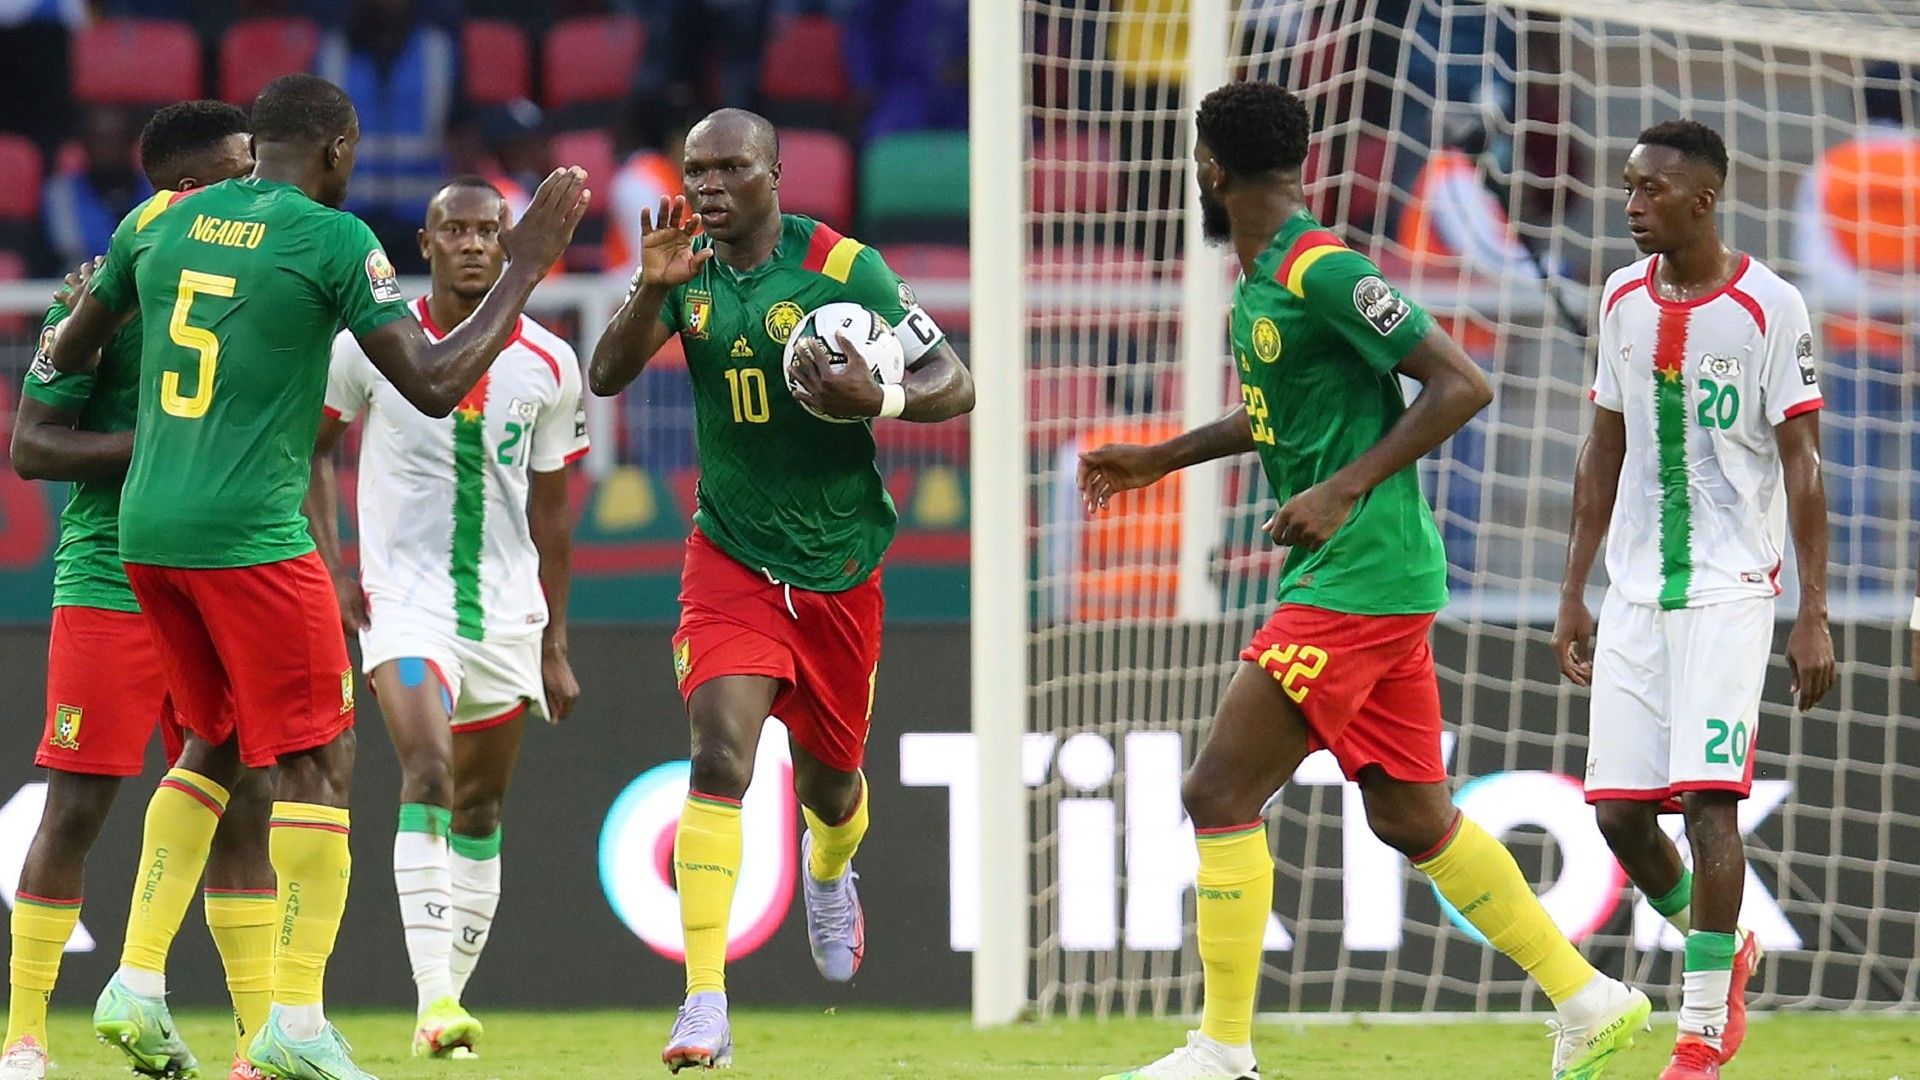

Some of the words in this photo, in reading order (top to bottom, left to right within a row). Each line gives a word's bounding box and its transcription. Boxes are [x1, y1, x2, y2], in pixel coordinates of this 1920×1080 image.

[187, 214, 266, 249] NGADEU
[160, 268, 237, 419] 5
[907, 313, 936, 346] C
[724, 368, 770, 423] 10
[1241, 383, 1275, 446] 22
[1697, 378, 1740, 430] 20
[497, 422, 532, 467] 21
[1258, 643, 1328, 703] 22
[1705, 718, 1747, 767] 20
[1586, 1017, 1626, 1049] NEMESIS
